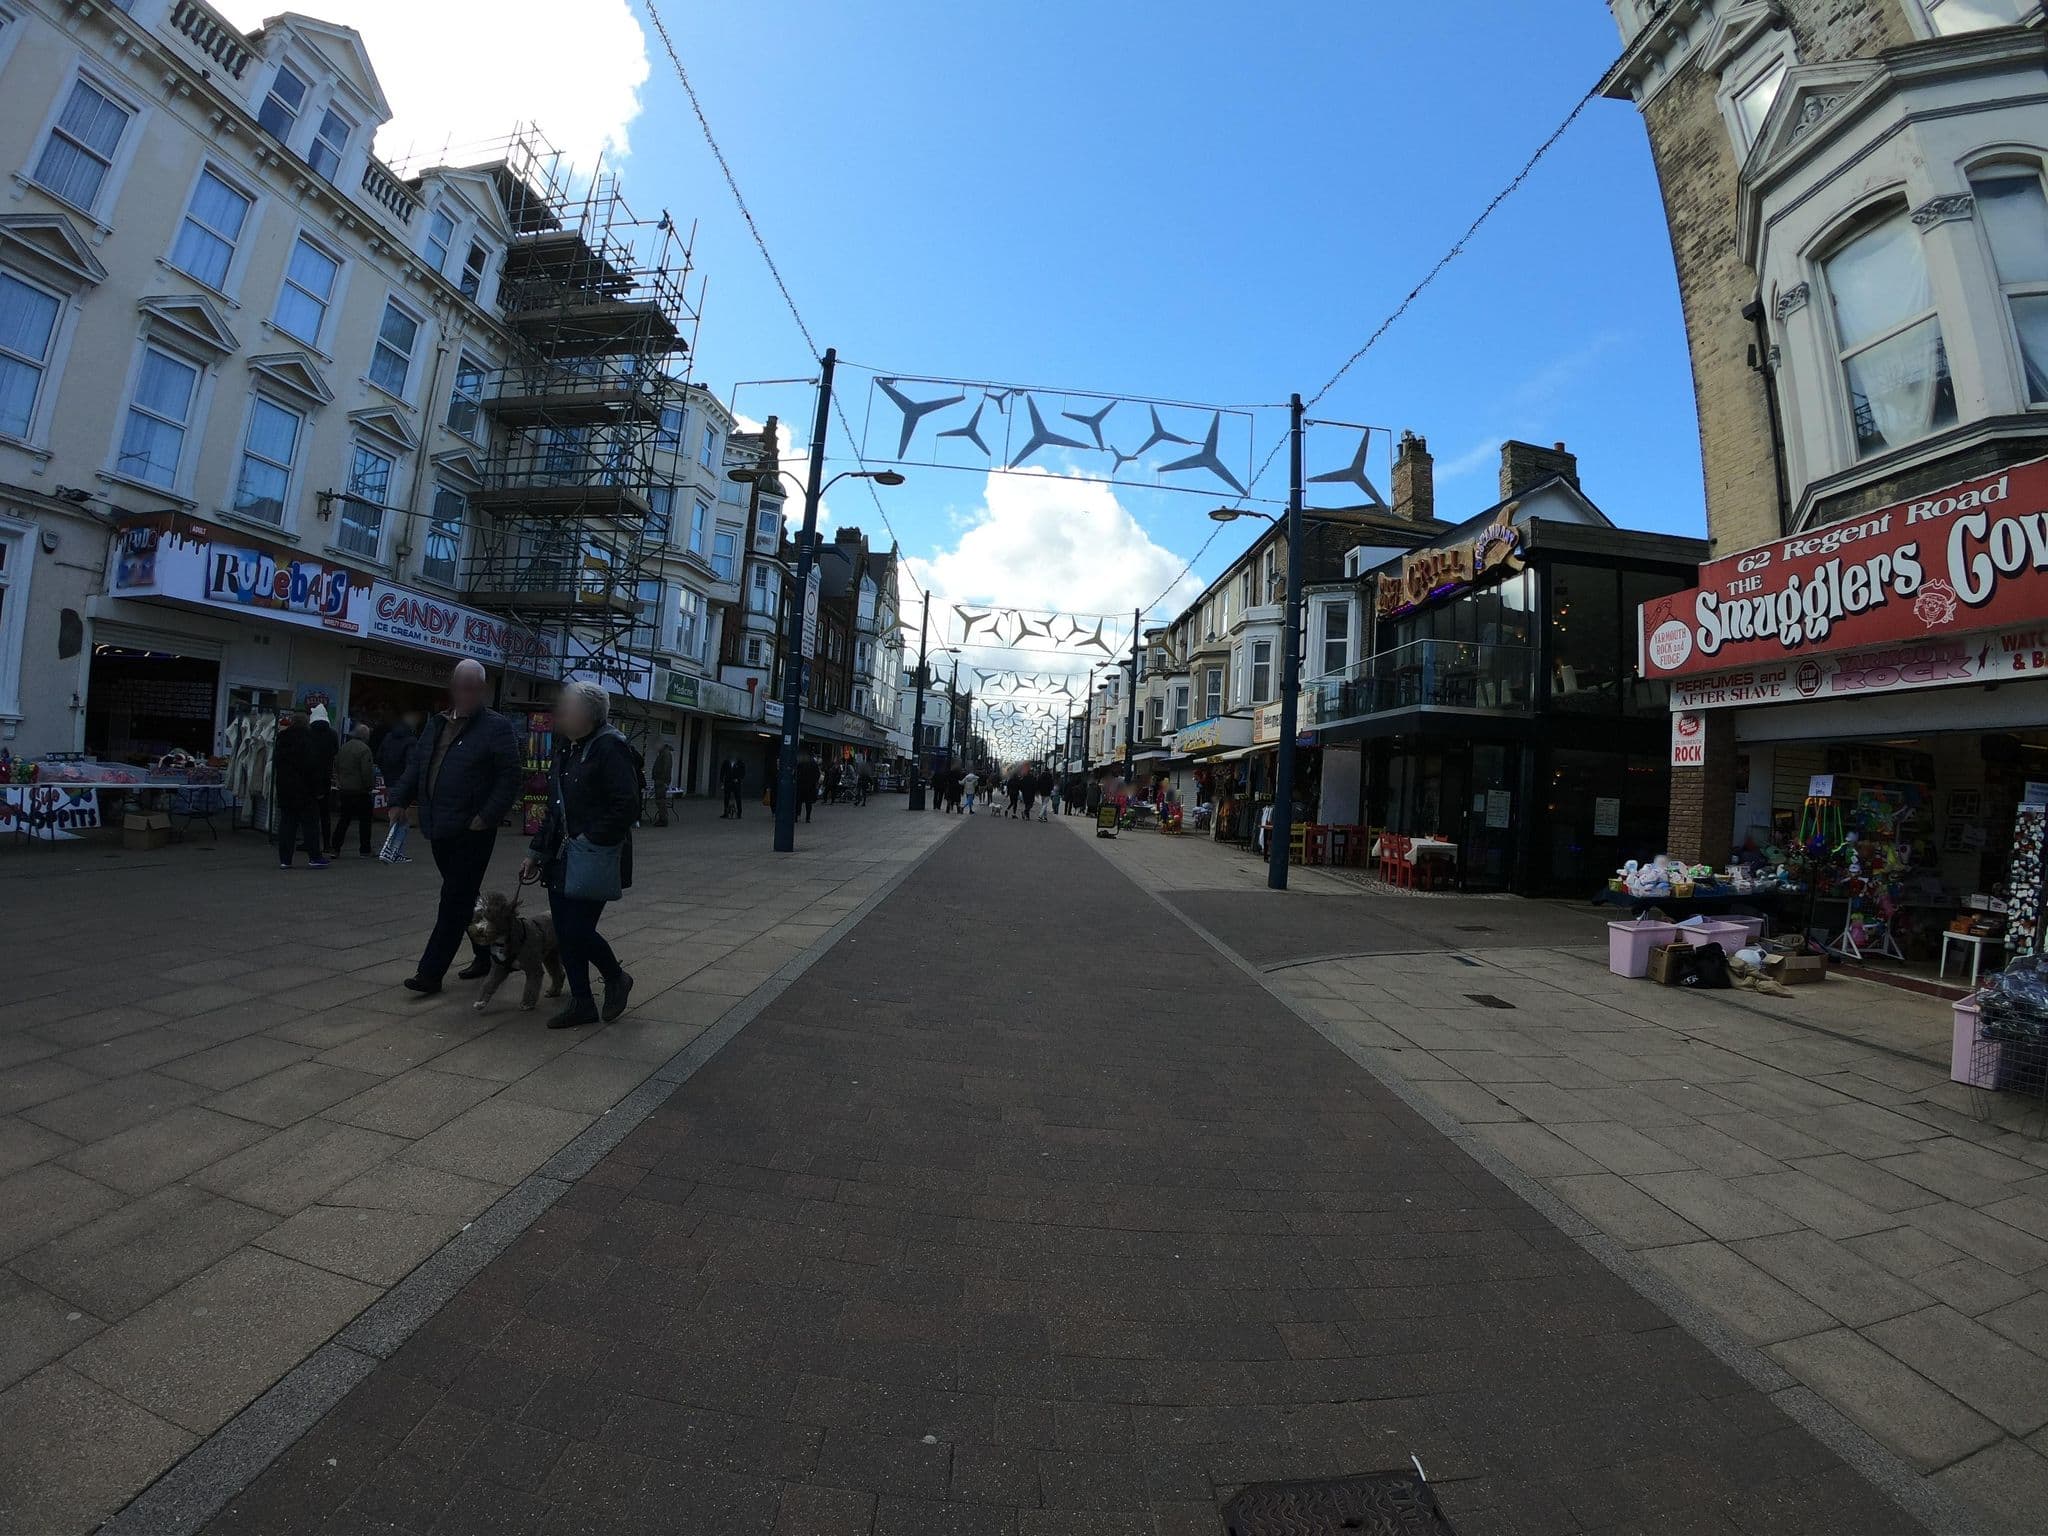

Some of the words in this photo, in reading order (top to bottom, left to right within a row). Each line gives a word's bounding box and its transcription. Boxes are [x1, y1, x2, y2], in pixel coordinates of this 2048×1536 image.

[1738, 552, 1771, 573] 62
[1782, 514, 1892, 561] Regent
[1904, 476, 2009, 526] Road
[1407, 549, 1465, 600] GRILL
[1727, 574, 1763, 597] THE
[1697, 543, 1919, 655] Smugglers
[376, 593, 460, 637] CANDY
[464, 616, 551, 657] KINGDOM
[1655, 628, 1687, 644] YARMOUTH
[374, 622, 388, 632] ICE
[391, 626, 421, 640] CREAM
[431, 636, 460, 650] SWEETS
[469, 646, 492, 658] FUDGE
[1656, 643, 1672, 655] ROCK
[1661, 652, 1681, 666] FUDGE
[1836, 642, 1967, 672] YARMOUTH
[2013, 653, 2025, 670] &
[2032, 651, 2048, 668] B
[1676, 672, 1753, 693] PERFUMES
[1761, 668, 1787, 682] and
[1832, 656, 1973, 691] ROCK
[1680, 689, 1726, 706] AFTER
[1730, 684, 1781, 700] SHAVE
[1675, 745, 1702, 762] ROCK
